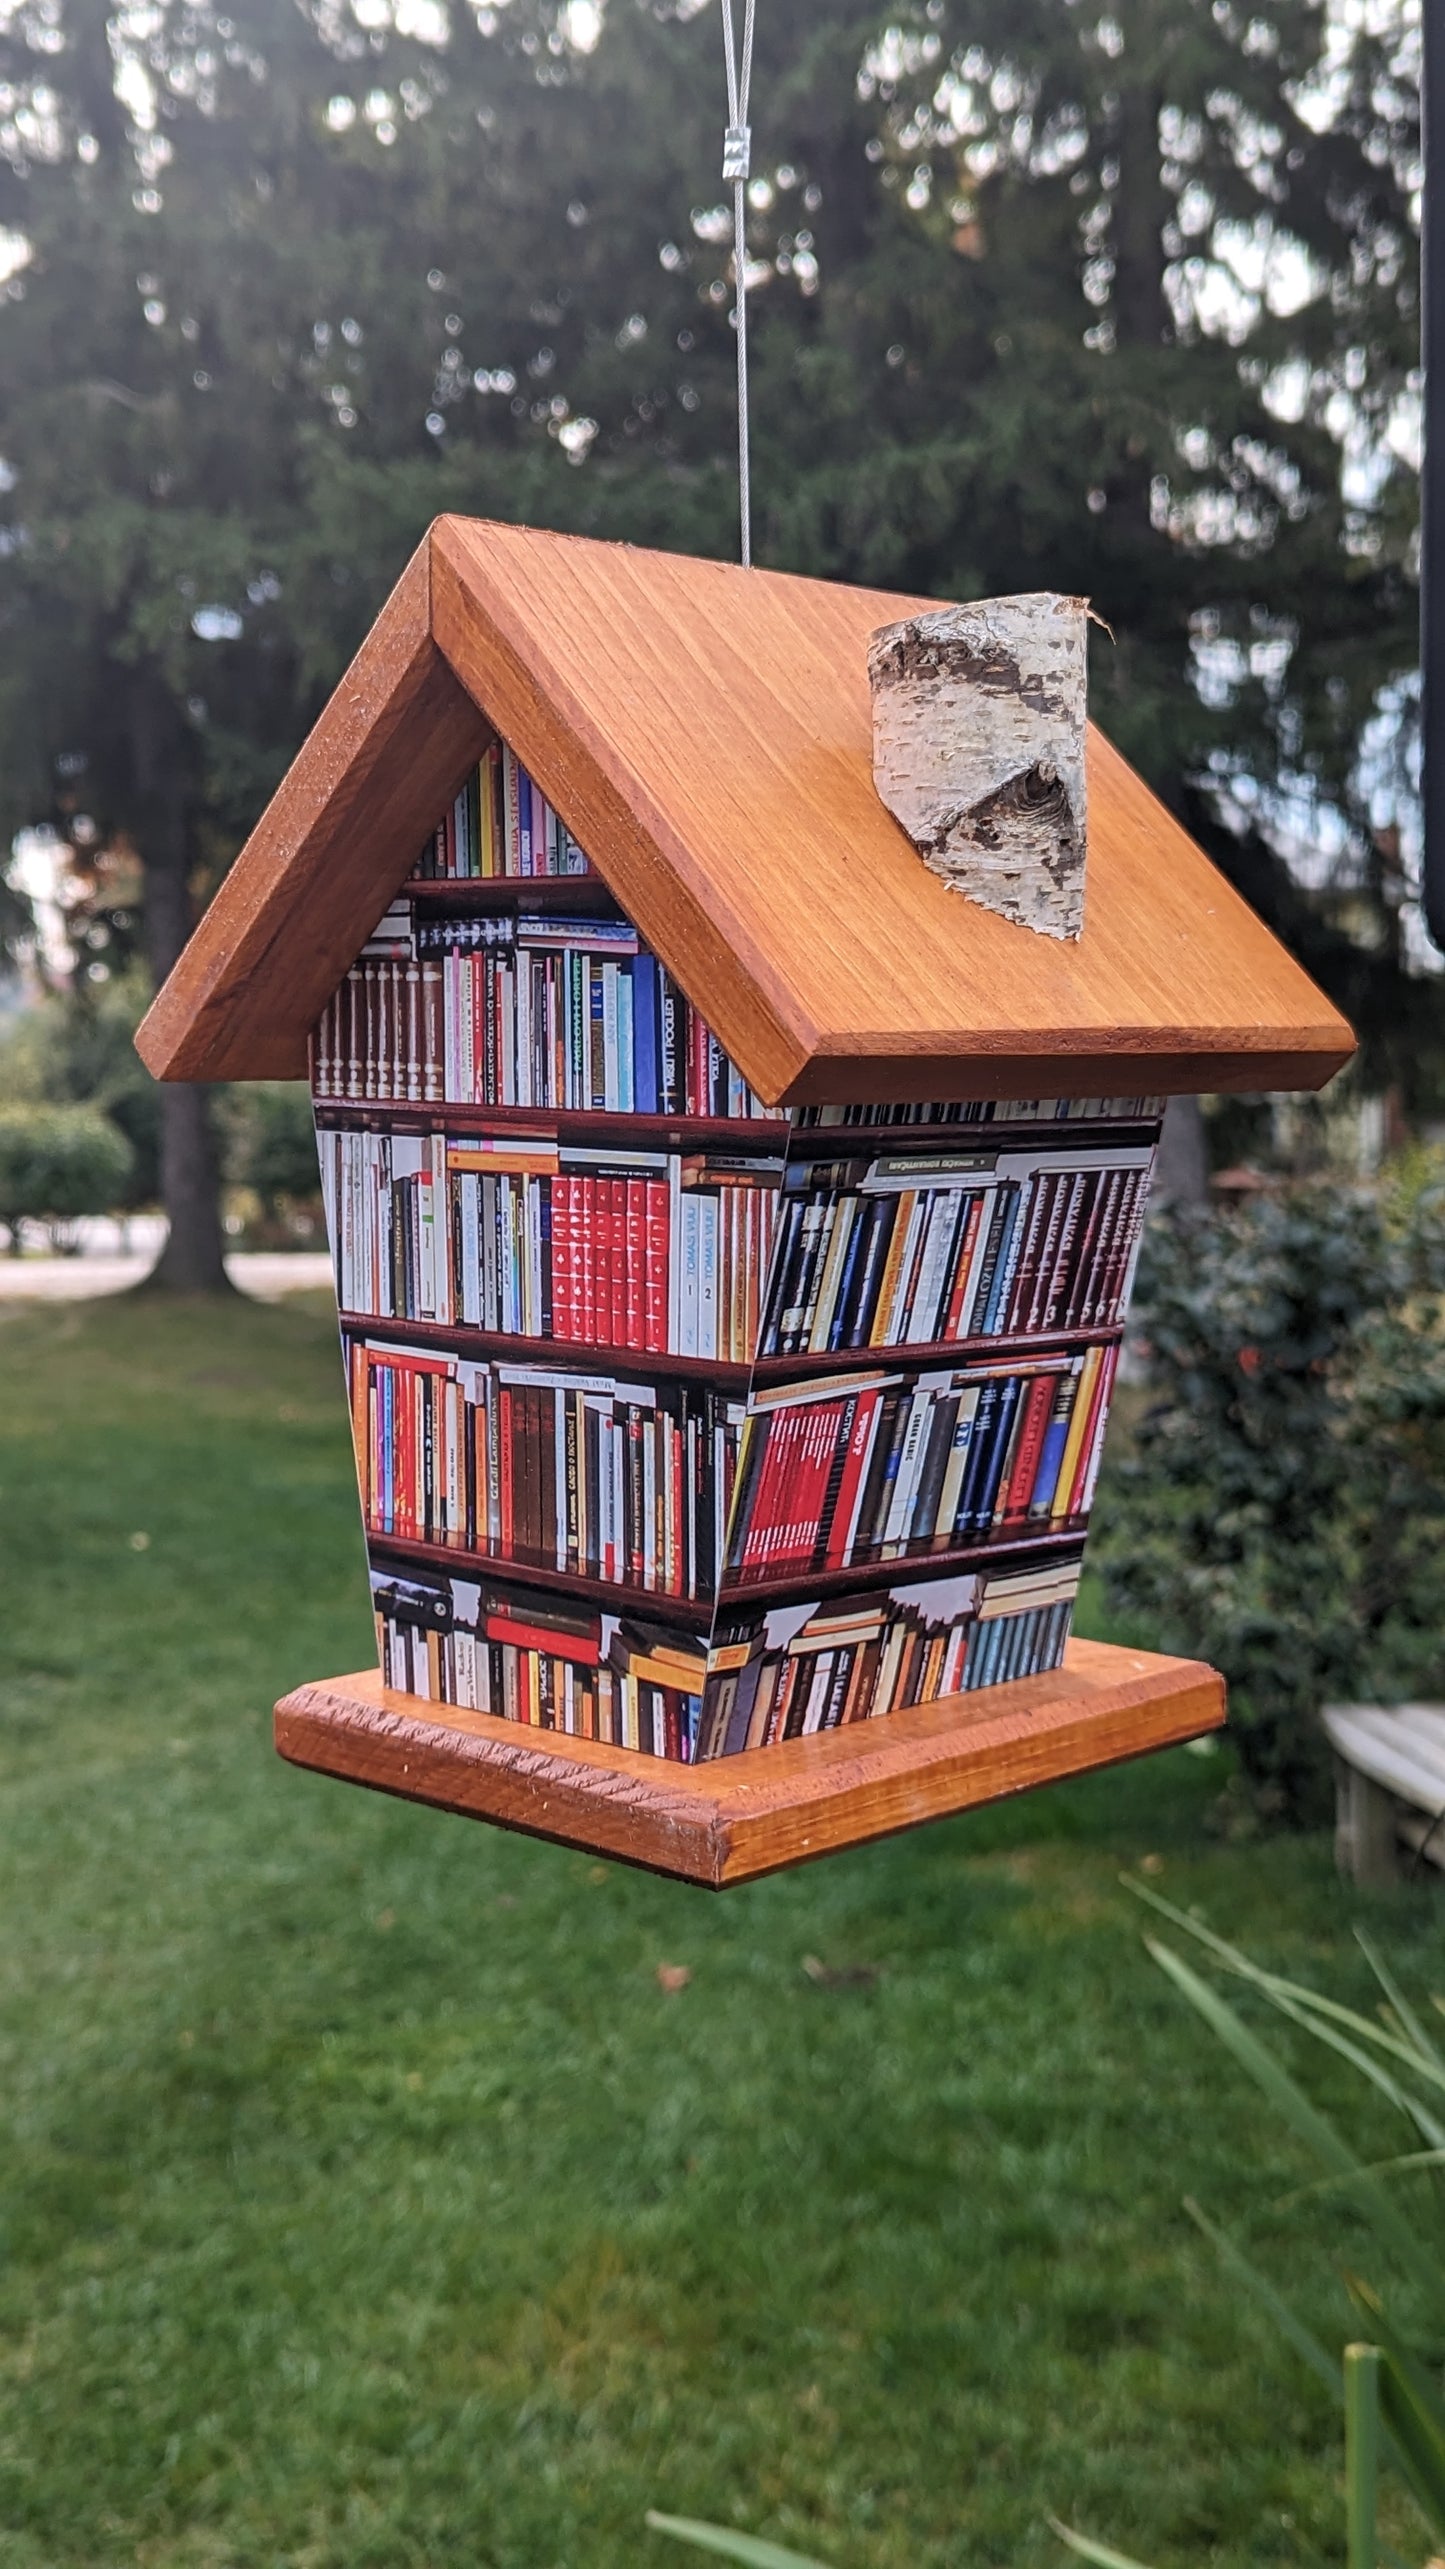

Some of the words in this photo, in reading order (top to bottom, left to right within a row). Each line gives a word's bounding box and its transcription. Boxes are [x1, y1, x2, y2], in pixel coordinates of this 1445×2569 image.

[664, 998, 674, 1046] POGLEDI
[665, 1058, 675, 1085] MISLI
[1027, 1179, 1049, 1254] БУЛГАКОВ
[1045, 1179, 1068, 1253] БУЛГАКОВ
[1061, 1178, 1087, 1252] БУЛГАКОВ
[686, 1236, 695, 1274] TOMAS
[704, 1238, 713, 1278] TOMAS
[704, 1287, 711, 1299] 2
[488, 1397, 500, 1465] Lampedusa
[839, 1400, 856, 1444] КОСТИЋ
[910, 1413, 922, 1438] GORAN
[905, 1439, 917, 1462] BABIĆ
